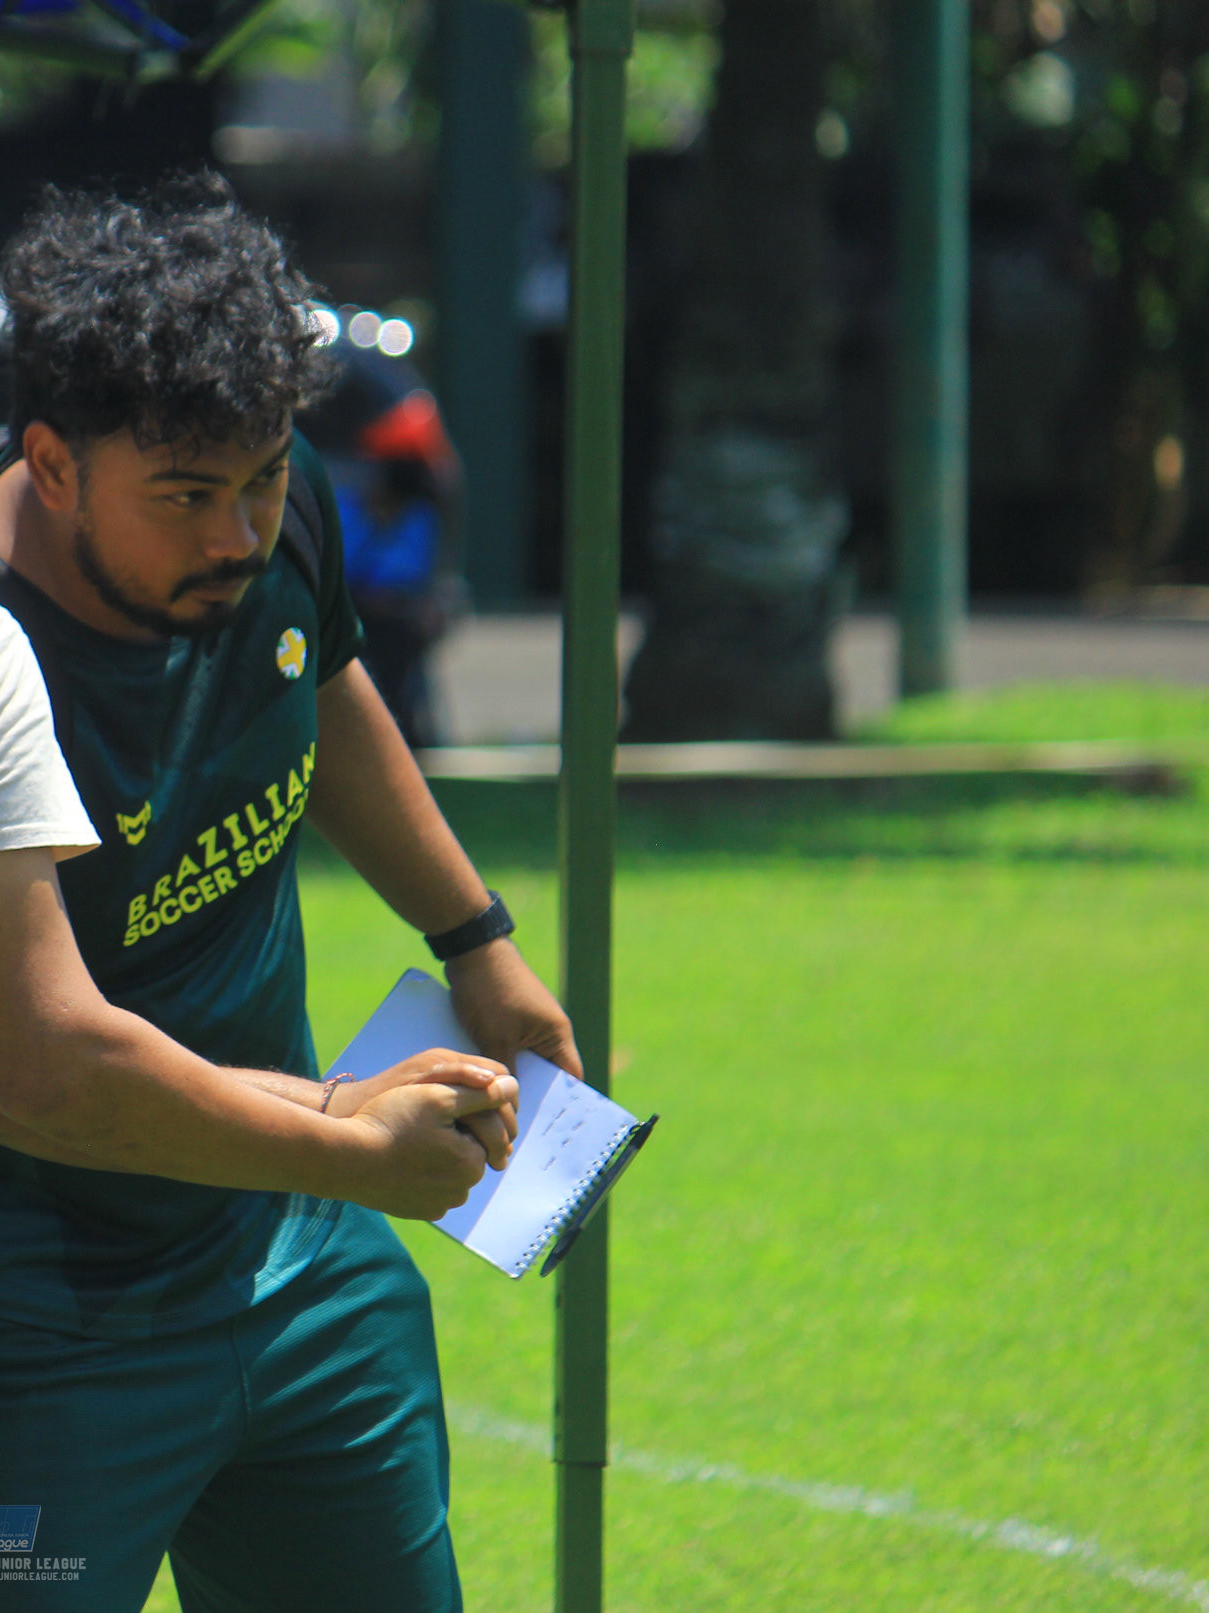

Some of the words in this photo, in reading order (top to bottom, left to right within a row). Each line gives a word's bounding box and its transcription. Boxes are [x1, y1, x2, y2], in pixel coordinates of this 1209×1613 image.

[123, 866, 238, 947] SOCCER
[236, 787, 309, 877] SCHOO
[128, 741, 316, 926] BRAZILIAN
